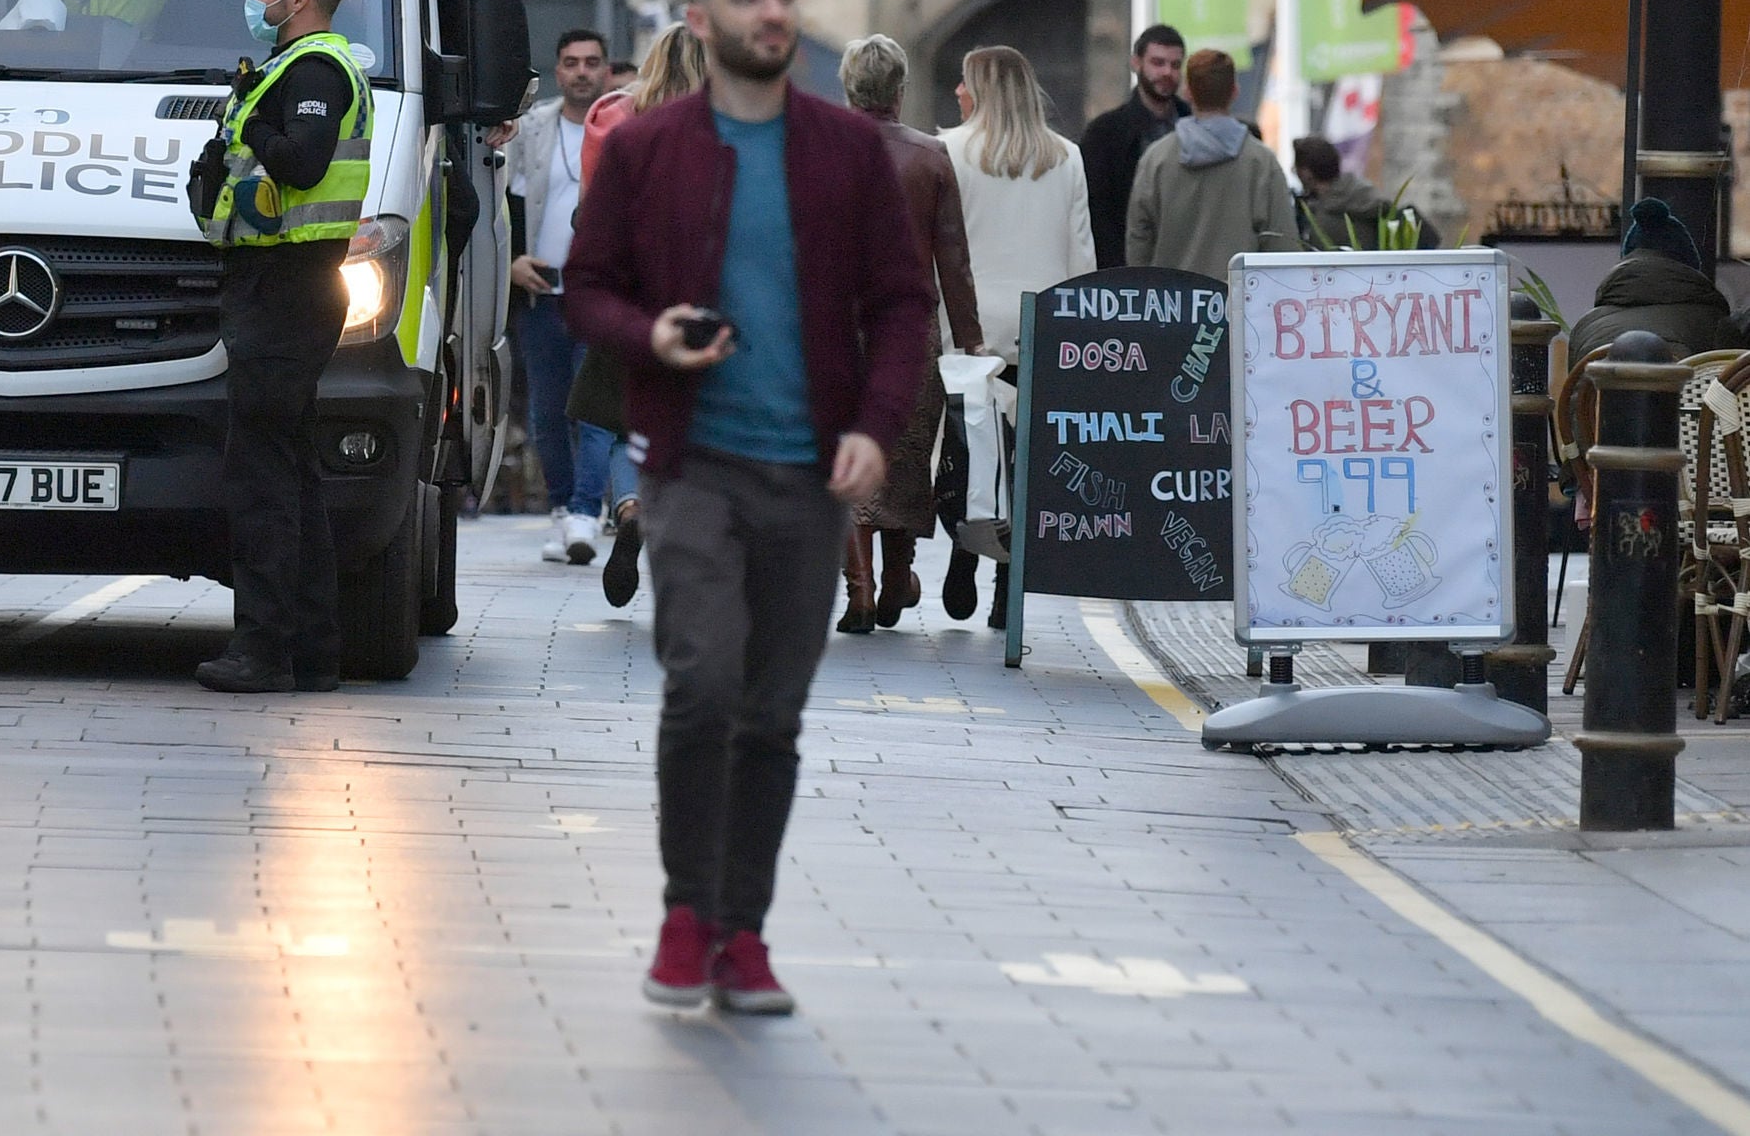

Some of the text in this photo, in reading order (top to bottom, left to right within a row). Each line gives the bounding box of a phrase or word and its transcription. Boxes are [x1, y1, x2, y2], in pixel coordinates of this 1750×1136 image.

[296, 107, 328, 117] POLICE
[1053, 287, 1230, 325] INDIAN FO
[1272, 289, 1482, 360] BIRYANI
[1058, 338, 1148, 373] DOSA
[1170, 323, 1225, 404] CHAI
[1350, 358, 1386, 399] &
[1046, 410, 1165, 445] THALI
[1290, 395, 1436, 456] BEER
[30, 468, 105, 504] BUE
[1048, 450, 1127, 511] FISH
[1296, 456, 1416, 515] 9.99
[1038, 510, 1133, 542] PRAWN
[1159, 510, 1225, 593] VEGAN
